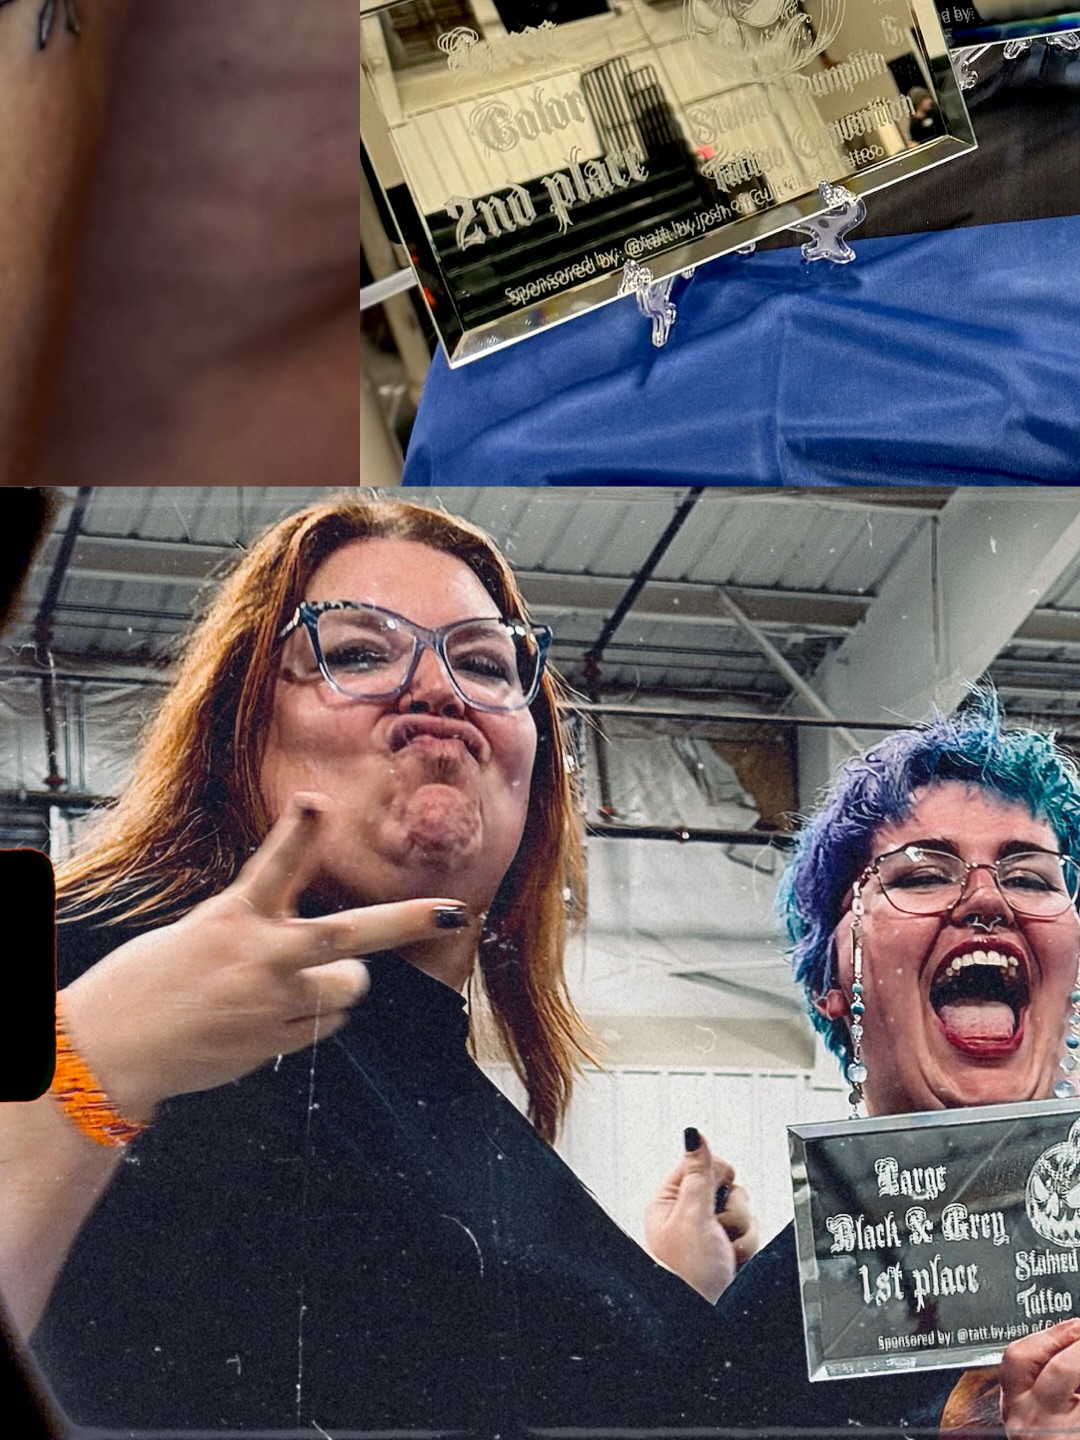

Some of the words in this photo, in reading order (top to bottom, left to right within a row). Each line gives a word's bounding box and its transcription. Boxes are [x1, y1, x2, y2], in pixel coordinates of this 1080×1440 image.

[471, 86, 586, 157] Color
[444, 179, 537, 251] 2nd
[541, 146, 649, 234] place
[875, 1157, 947, 1200] Large
[826, 1211, 902, 1253] Black
[941, 1203, 1010, 1246] Grey
[859, 1262, 904, 1306] 1st
[912, 1254, 979, 1312] place
[1016, 1283, 1073, 1318] Tattoo
